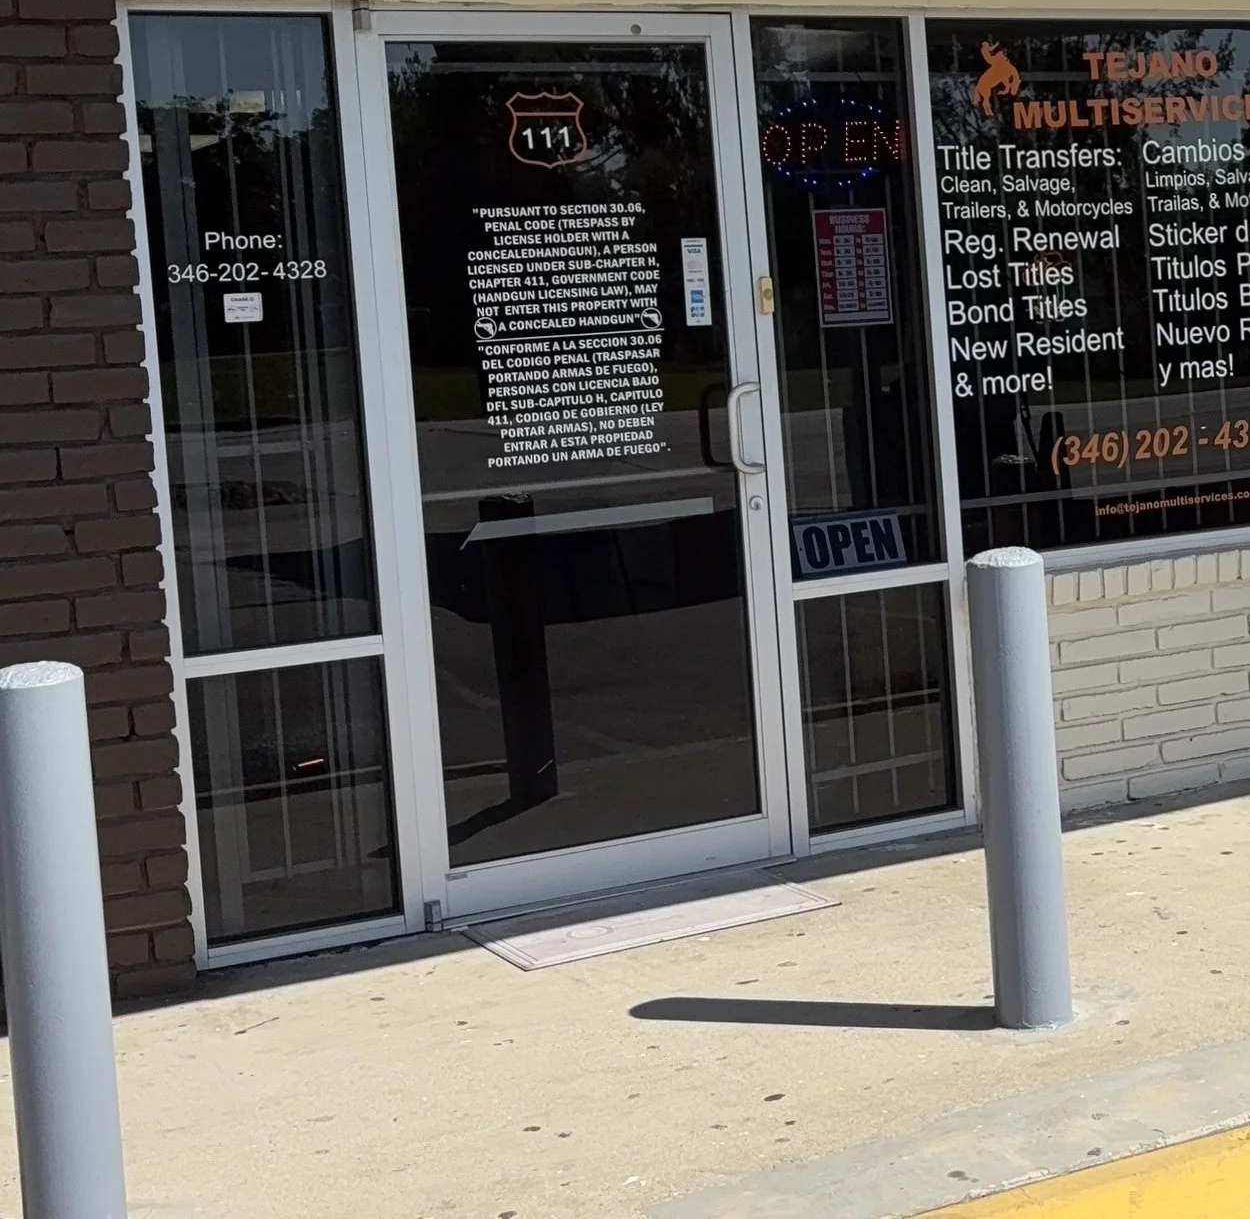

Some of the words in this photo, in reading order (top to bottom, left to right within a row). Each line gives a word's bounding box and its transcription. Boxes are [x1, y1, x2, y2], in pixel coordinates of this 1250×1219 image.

[1083, 50, 1218, 80] TEJANO
[522, 126, 571, 150] 111
[762, 119, 902, 166] OPEN
[1142, 137, 1245, 164] Cambios
[937, 145, 991, 170] Title
[998, 142, 1122, 169] Transfers:
[941, 175, 997, 195] Clean,
[1002, 174, 1075, 195] Salvage,
[1145, 171, 1210, 191] Limpios,
[472, 206, 542, 218] "PURSUANT
[542, 205, 558, 216] TO
[559, 203, 607, 216] SECTION
[609, 202, 646, 214] 30.06,
[941, 201, 1011, 220] Trailers,
[1017, 200, 1030, 218] &
[1035, 198, 1133, 220] Motorcycles
[1147, 194, 1203, 212] Trailas,
[1209, 192, 1221, 209] &
[484, 221, 522, 232] PENAL
[524, 219, 556, 231] CODE
[557, 217, 619, 231] (TRESPASS
[621, 216, 636, 227] BY
[1149, 221, 1228, 247] Sticker
[204, 231, 283, 250] Phone:
[944, 229, 1004, 260] Reg.
[1013, 224, 1120, 252] Renewal
[946, 264, 1001, 289] Lost
[1007, 261, 1074, 287] Titles
[1150, 254, 1227, 280] Titulos
[948, 297, 1014, 326] Bond
[1022, 294, 1088, 320] Titles
[1152, 287, 1228, 313] Titulos
[478, 341, 551, 356] "CONFORME
[552, 341, 561, 351] A
[562, 340, 577, 351] LA
[578, 336, 628, 350] SECCION
[630, 334, 662, 346] 30.06
[951, 336, 1008, 362] New
[1016, 326, 1125, 357] Resident
[1156, 322, 1230, 346] Nuevo
[482, 359, 505, 370] DEL
[506, 355, 551, 369] CODIGO
[553, 353, 591, 365] PENAL
[592, 348, 661, 365] (TRASPASAR
[1159, 362, 1172, 387] y
[1180, 353, 1234, 379] mas!
[955, 372, 974, 398] &
[982, 366, 1053, 395] more!
[802, 518, 900, 570] OPEN
